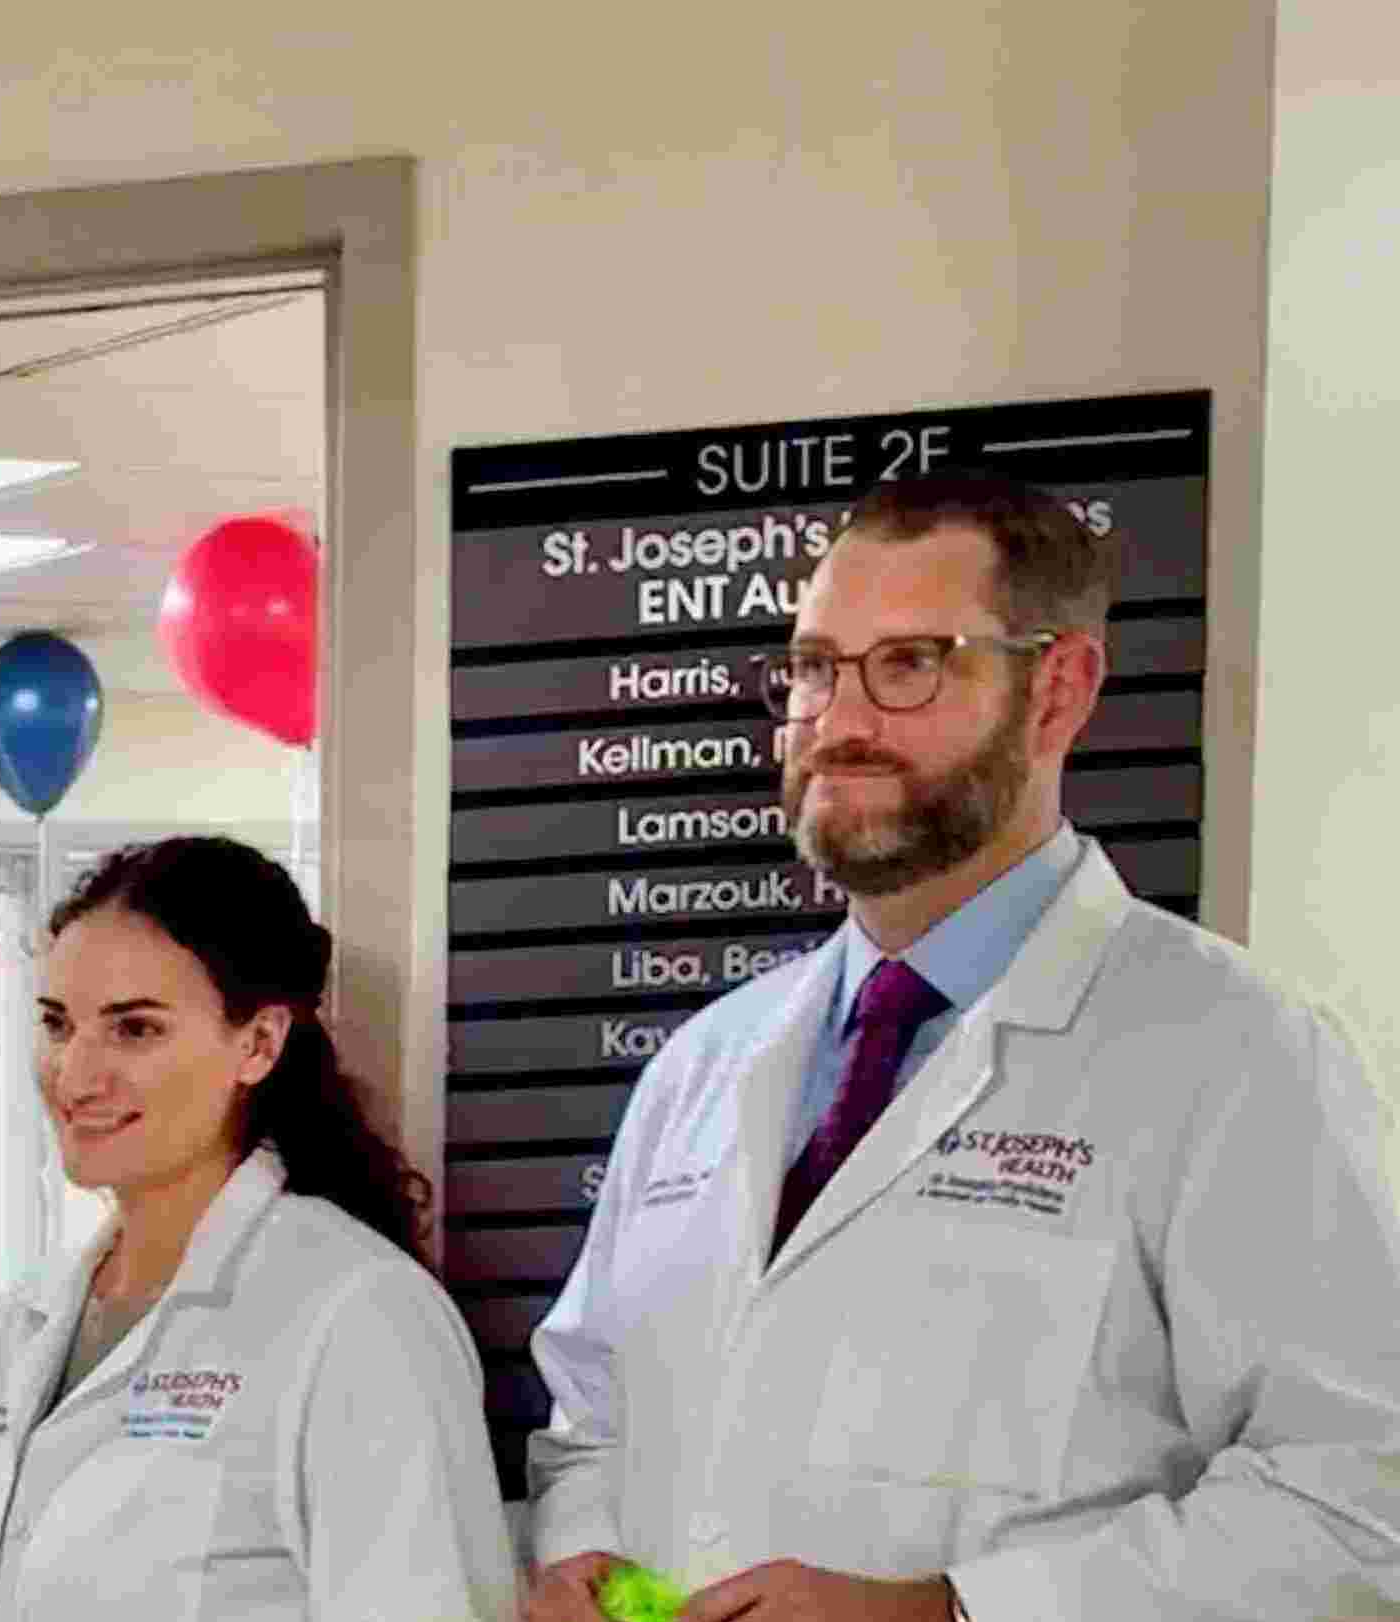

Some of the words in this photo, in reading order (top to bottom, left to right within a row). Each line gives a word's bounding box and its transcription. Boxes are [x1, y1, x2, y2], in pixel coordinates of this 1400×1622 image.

[696, 434, 854, 495] SUITE
[542, 531, 599, 577] St.
[608, 515, 831, 573] Joseph's
[639, 574, 730, 625] ENT
[609, 657, 742, 701] Harris,
[577, 735, 762, 777] Kellman,
[607, 870, 801, 916] Marzouk,
[612, 949, 713, 988] Liba,
